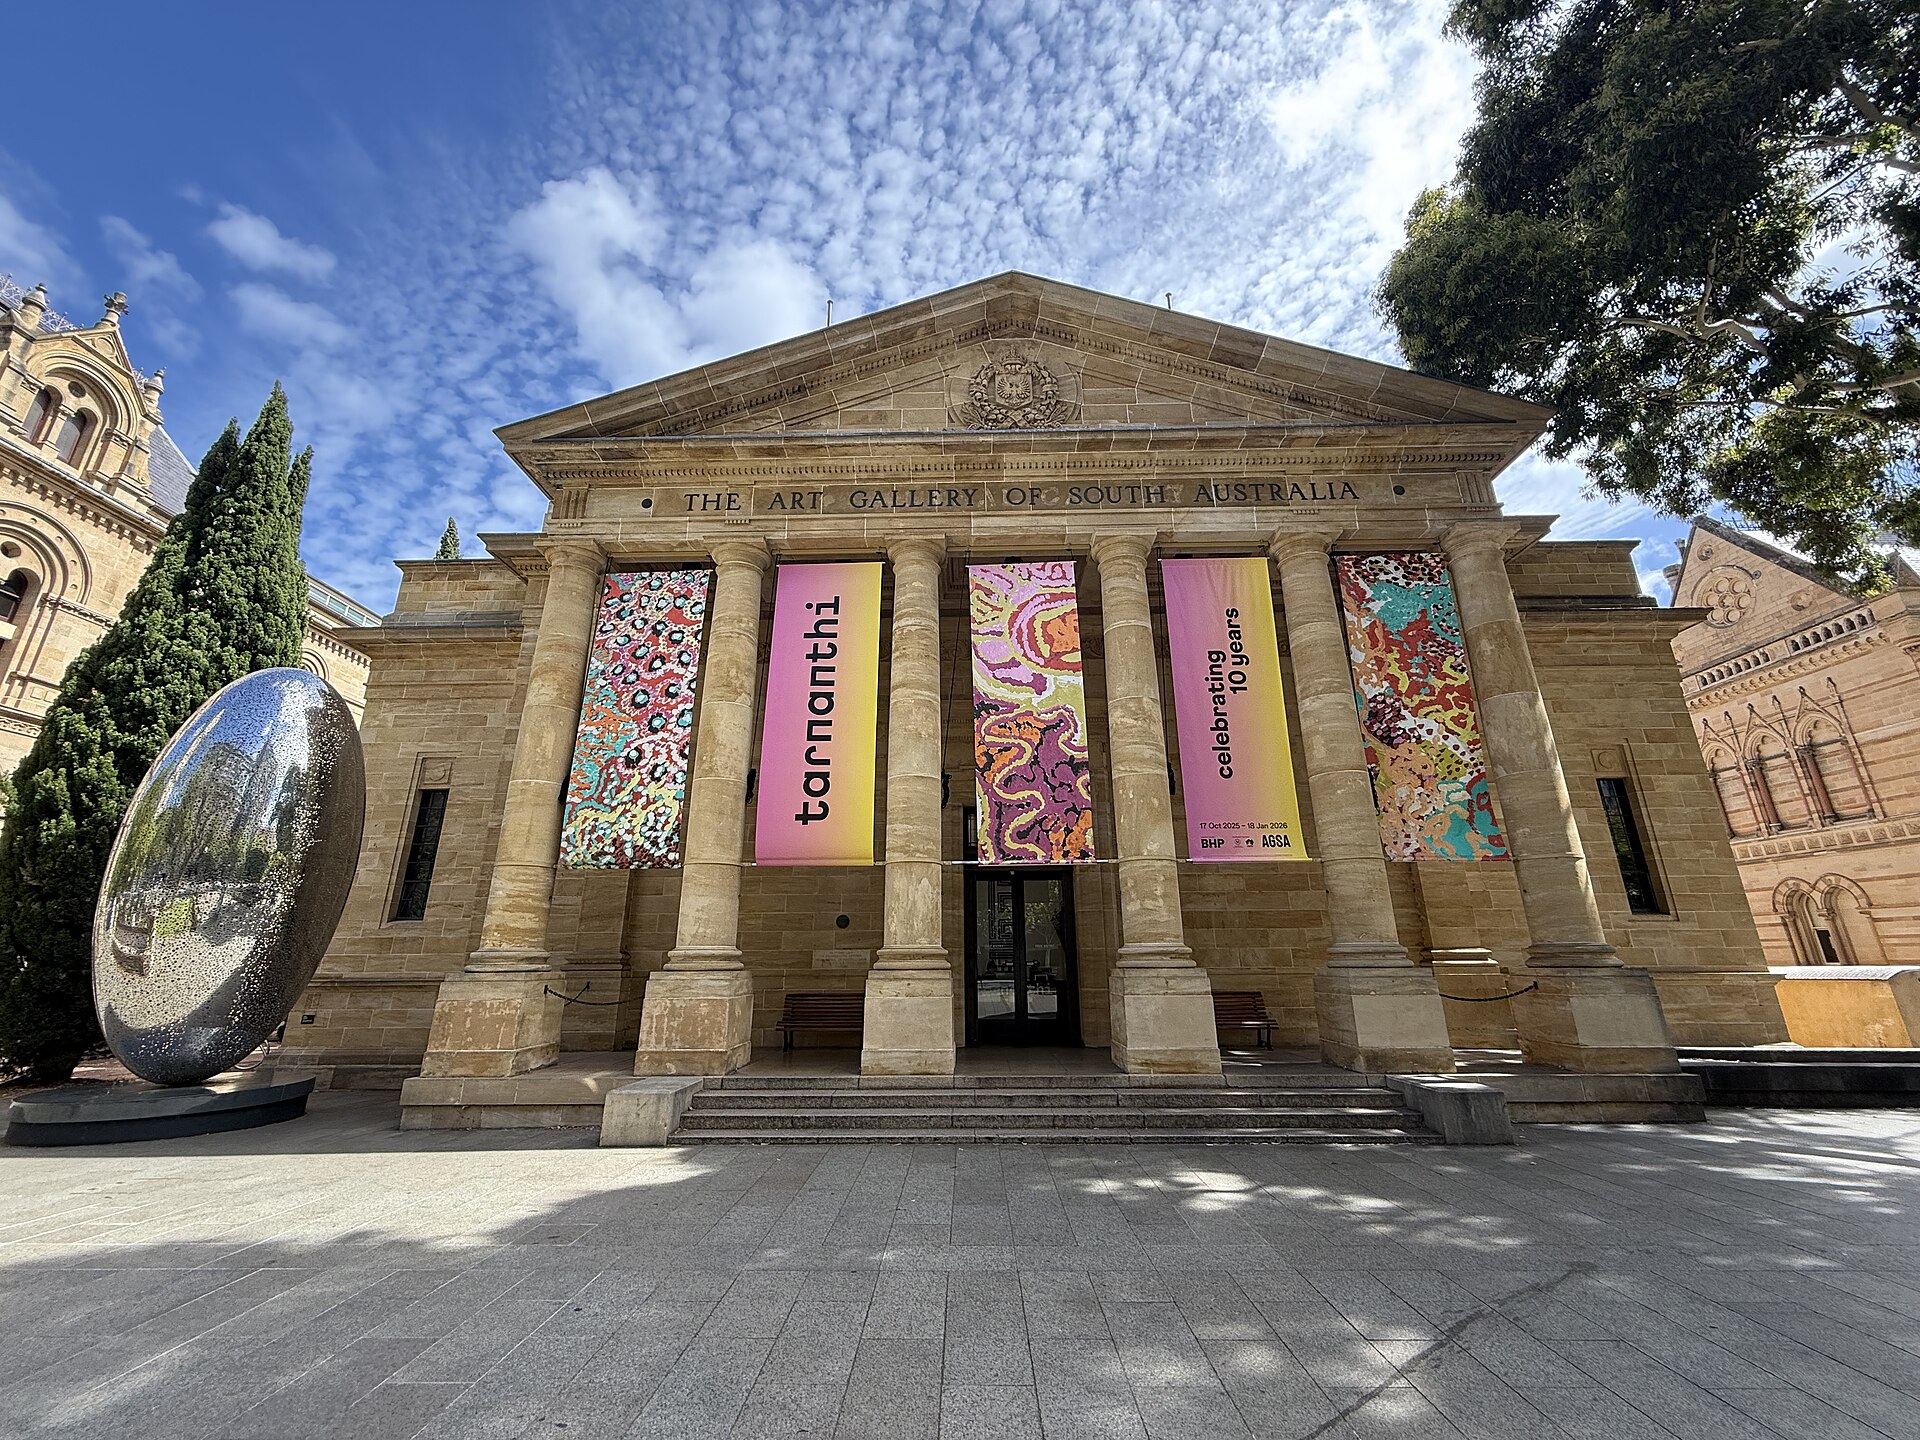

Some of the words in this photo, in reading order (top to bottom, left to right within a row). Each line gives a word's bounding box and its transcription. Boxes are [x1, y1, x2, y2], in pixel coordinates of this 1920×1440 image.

[684, 492, 741, 512] THE
[768, 490, 823, 510] ART
[850, 488, 979, 509] GALLERY
[1006, 487, 1042, 506] OF
[1069, 485, 1166, 505] SOUTH
[1193, 481, 1360, 502] AUSTRALIA
[1226, 607, 1250, 666] years
[1228, 670, 1248, 695] 10
[795, 596, 840, 826] tarnanthi
[1205, 650, 1233, 780] celebrating
[1208, 822, 1221, 830] Oct
[1222, 822, 1241, 830] 2025
[1256, 822, 1269, 830] Jan
[1201, 838, 1225, 848] BHP
[1262, 834, 1292, 848] AGSA
